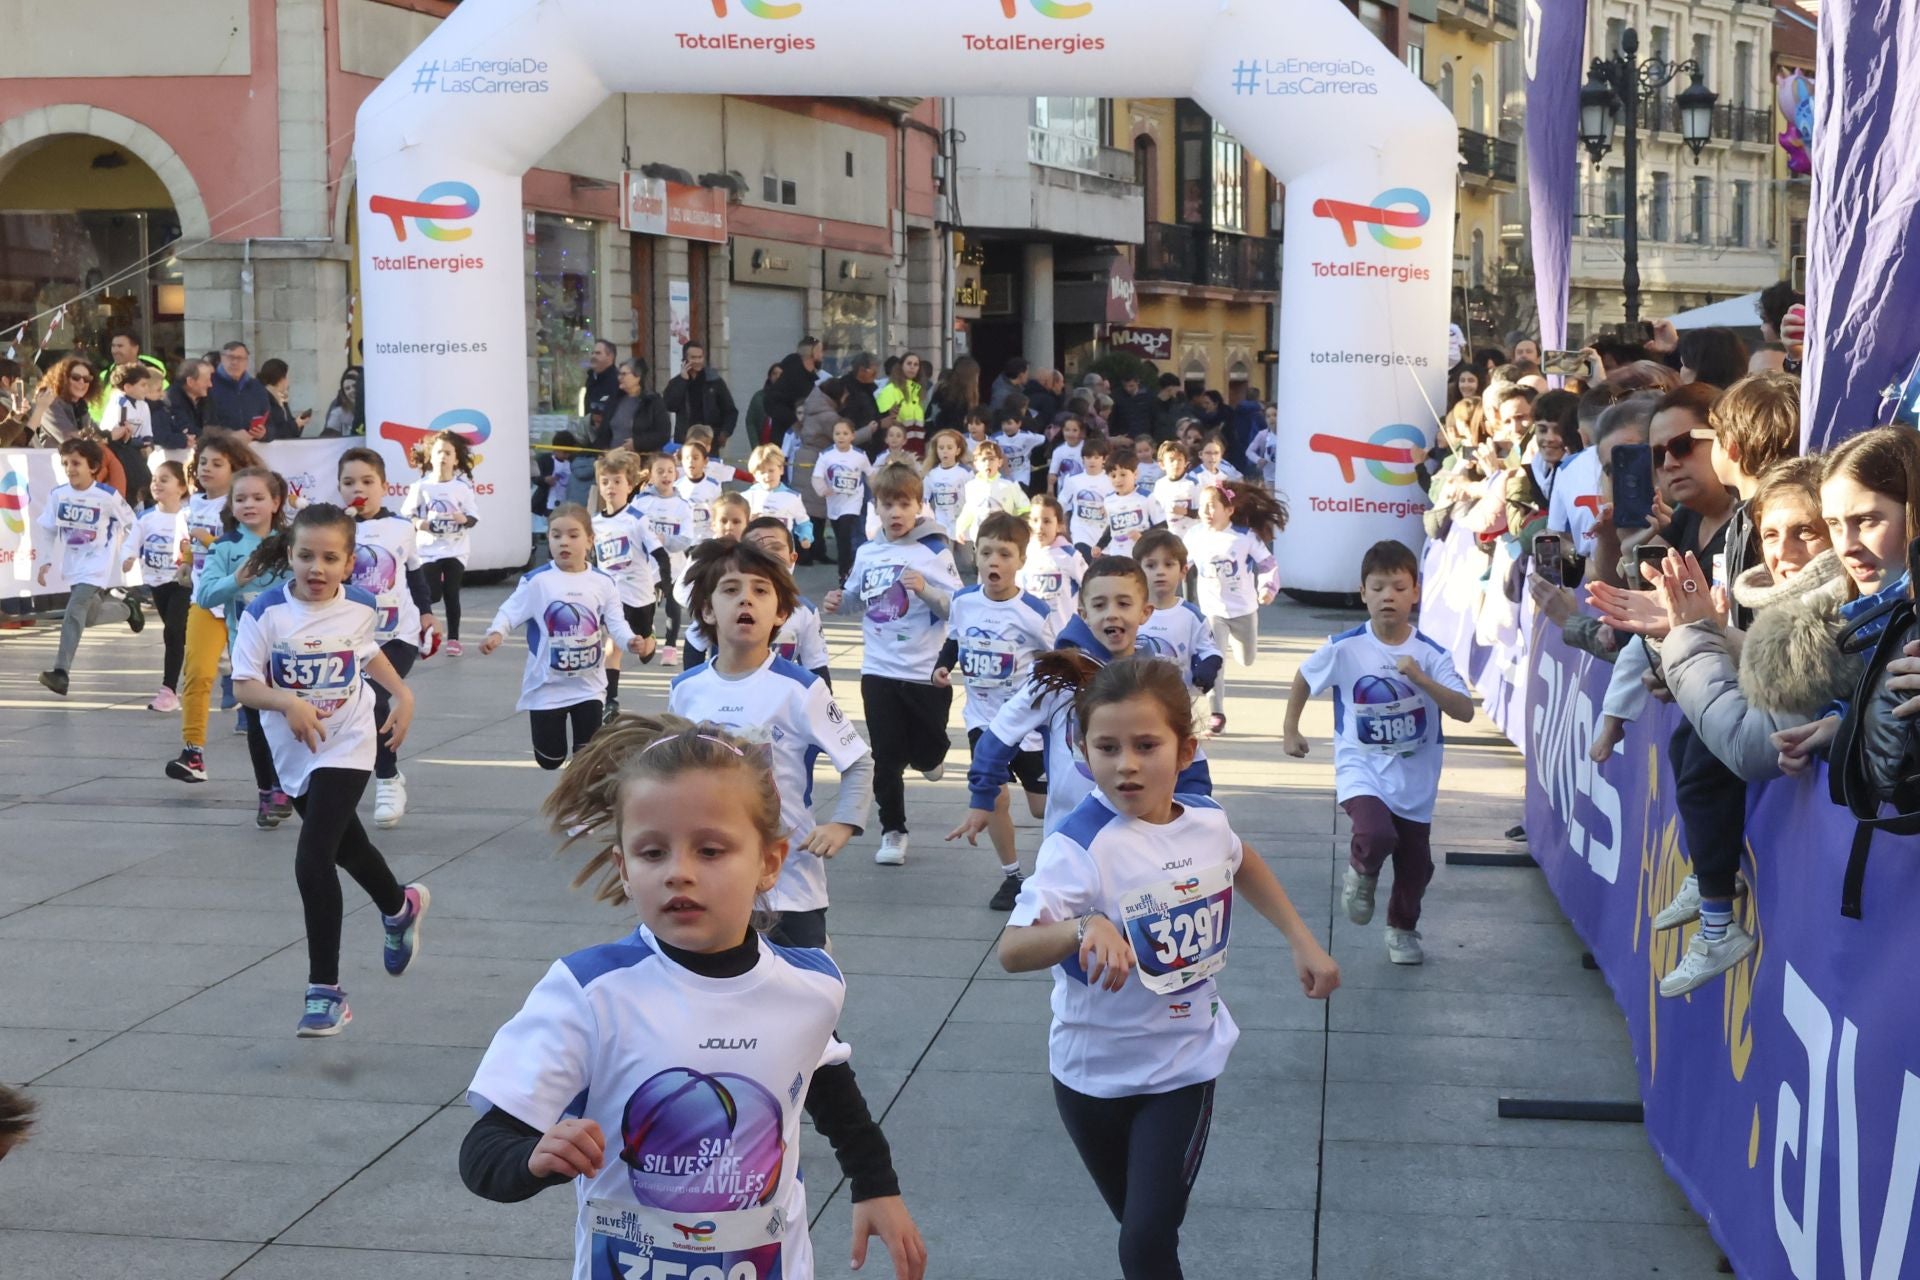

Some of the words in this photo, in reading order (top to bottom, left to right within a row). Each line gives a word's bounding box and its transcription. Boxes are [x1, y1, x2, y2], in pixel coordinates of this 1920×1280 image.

[675, 32, 815, 54] TotalEnergies
[963, 33, 1105, 54] TotalEnergies
[441, 76, 549, 93] LasCarreras
[1266, 77, 1378, 95] LasCarreras
[372, 253, 483, 273] TotalEnergies
[1312, 262, 1430, 282] TotalEnergies
[376, 340, 487, 356] totalenergies.es
[1311, 350, 1428, 367] totalenergies.es
[63, 504, 95, 522] 3079
[1309, 497, 1425, 518] TotalEnergies
[865, 567, 896, 589] 3674
[558, 646, 598, 669] 3550
[964, 651, 1003, 676] 3193
[282, 656, 345, 685] 3372
[1369, 714, 1417, 741] 3188
[1149, 899, 1225, 964] 3297
[699, 1037, 757, 1050] JOLUVI
[698, 1137, 735, 1157] SAN
[643, 1153, 743, 1177] SILVESTRE
[702, 1170, 766, 1194] AVILÉS
[621, 1210, 639, 1223] SAN
[625, 1232, 655, 1245] AVILÉS
